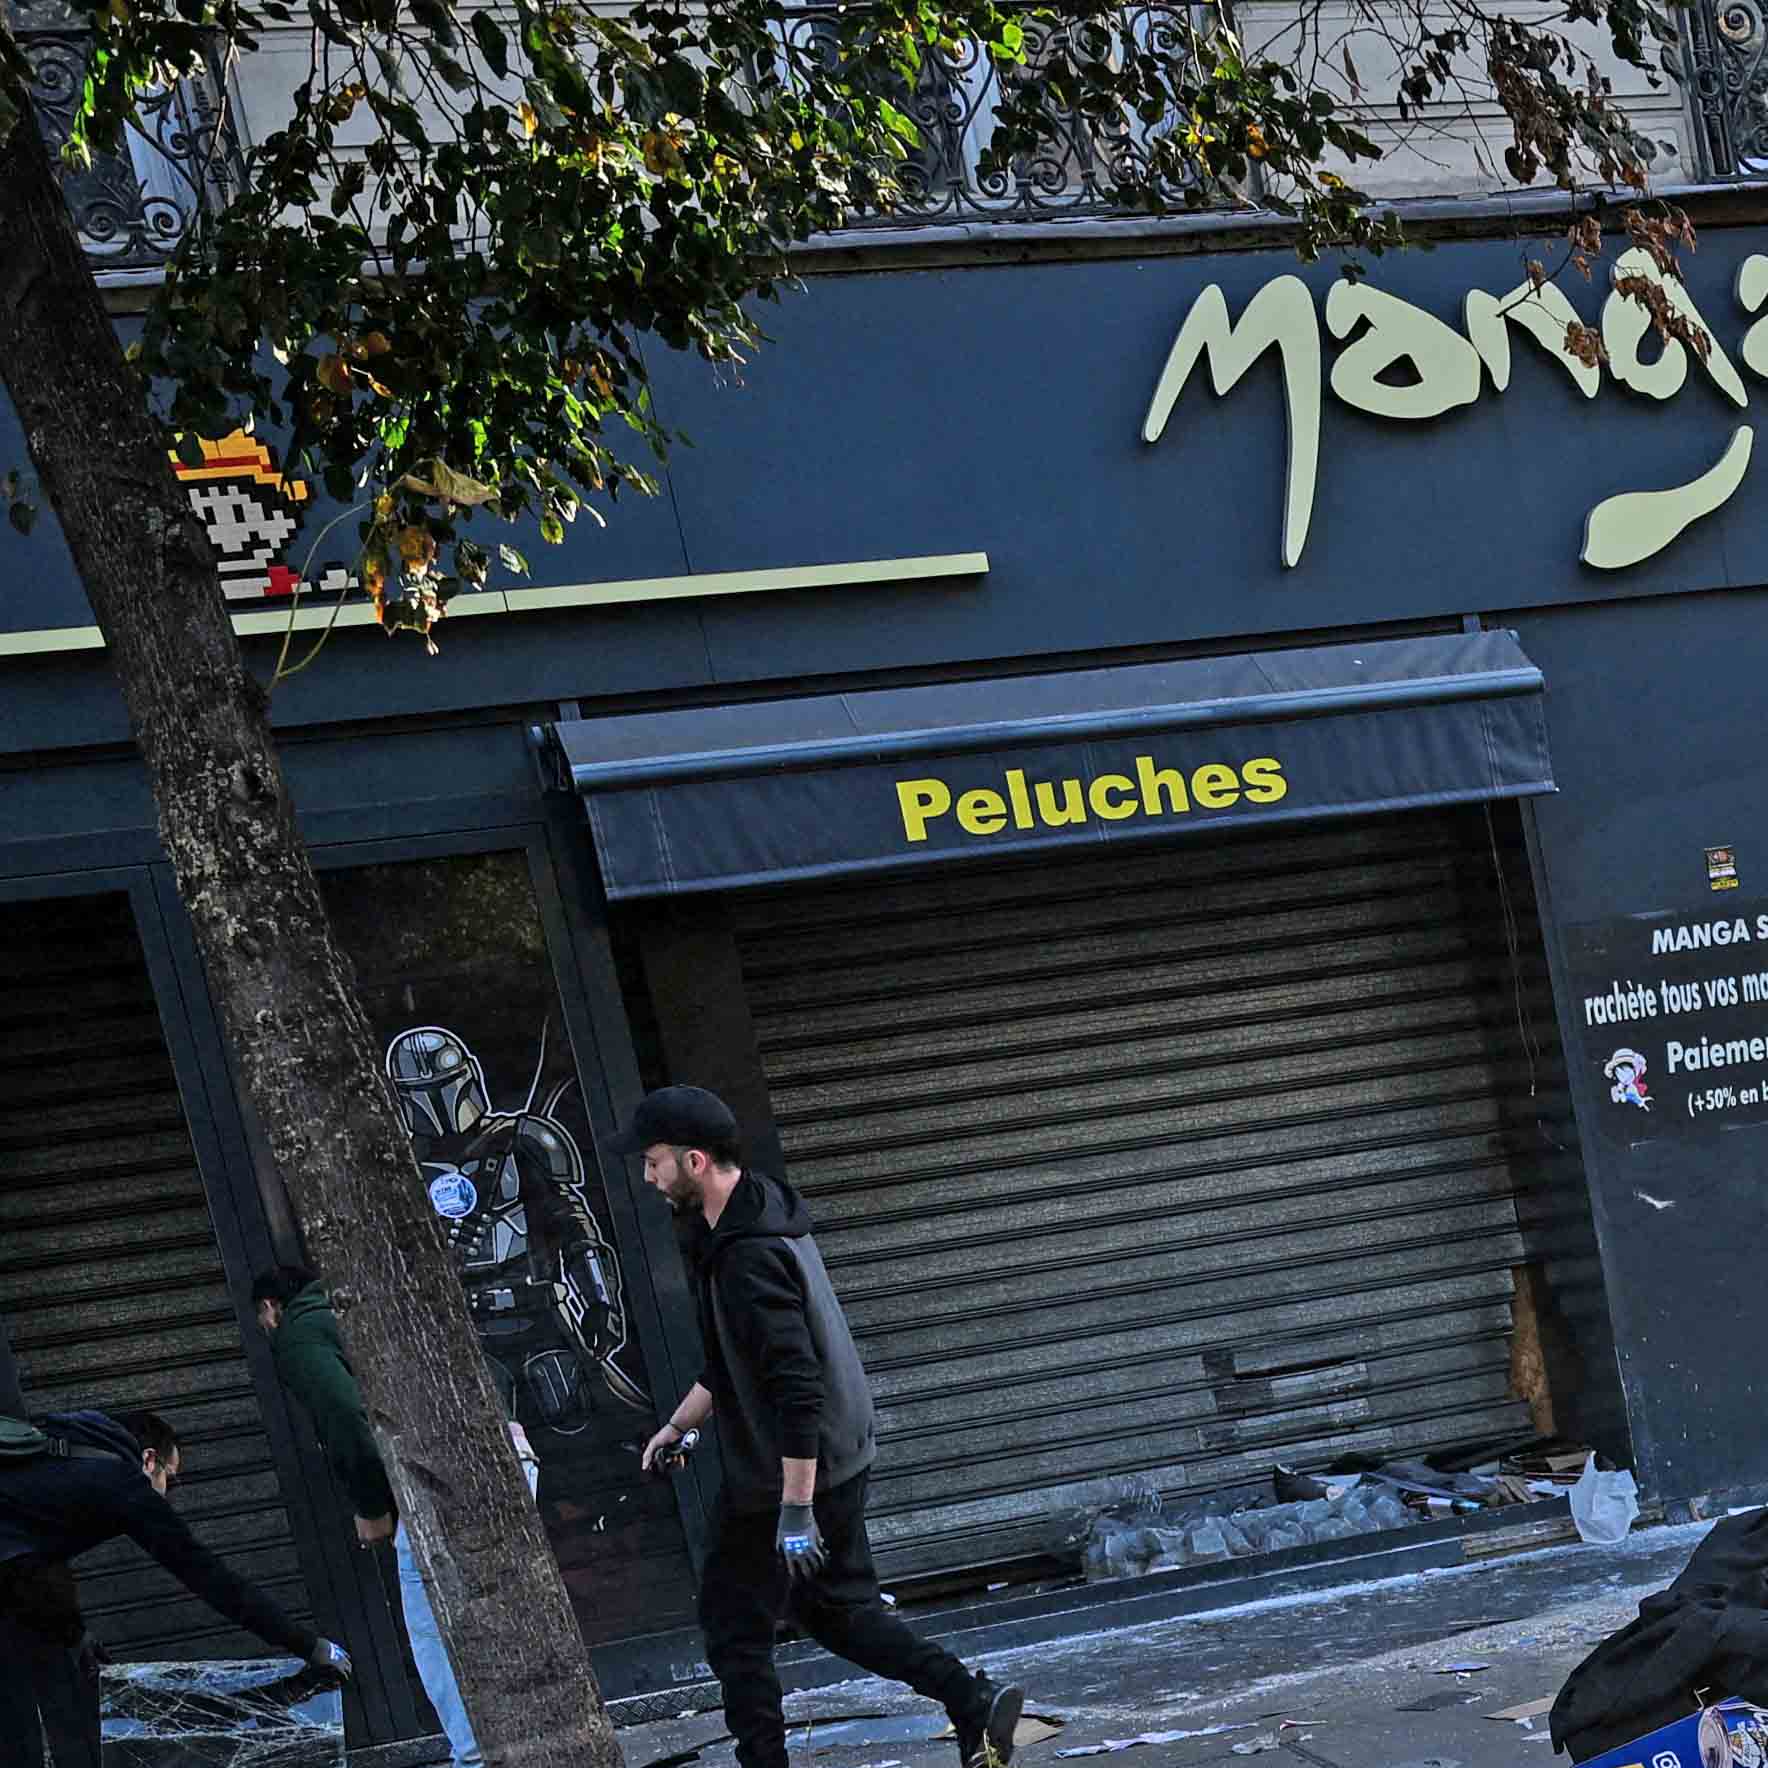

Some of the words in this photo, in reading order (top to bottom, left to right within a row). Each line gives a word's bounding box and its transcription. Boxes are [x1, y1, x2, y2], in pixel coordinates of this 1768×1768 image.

[895, 756, 1288, 843] Peluches
[1651, 920, 1751, 956] MANGA
[1584, 980, 1658, 1026] rachète
[1660, 981, 1702, 1015] tous
[1703, 978, 1738, 1008] vos
[1687, 1085, 1737, 1118] (+50%
[1740, 1083, 1759, 1106] en
